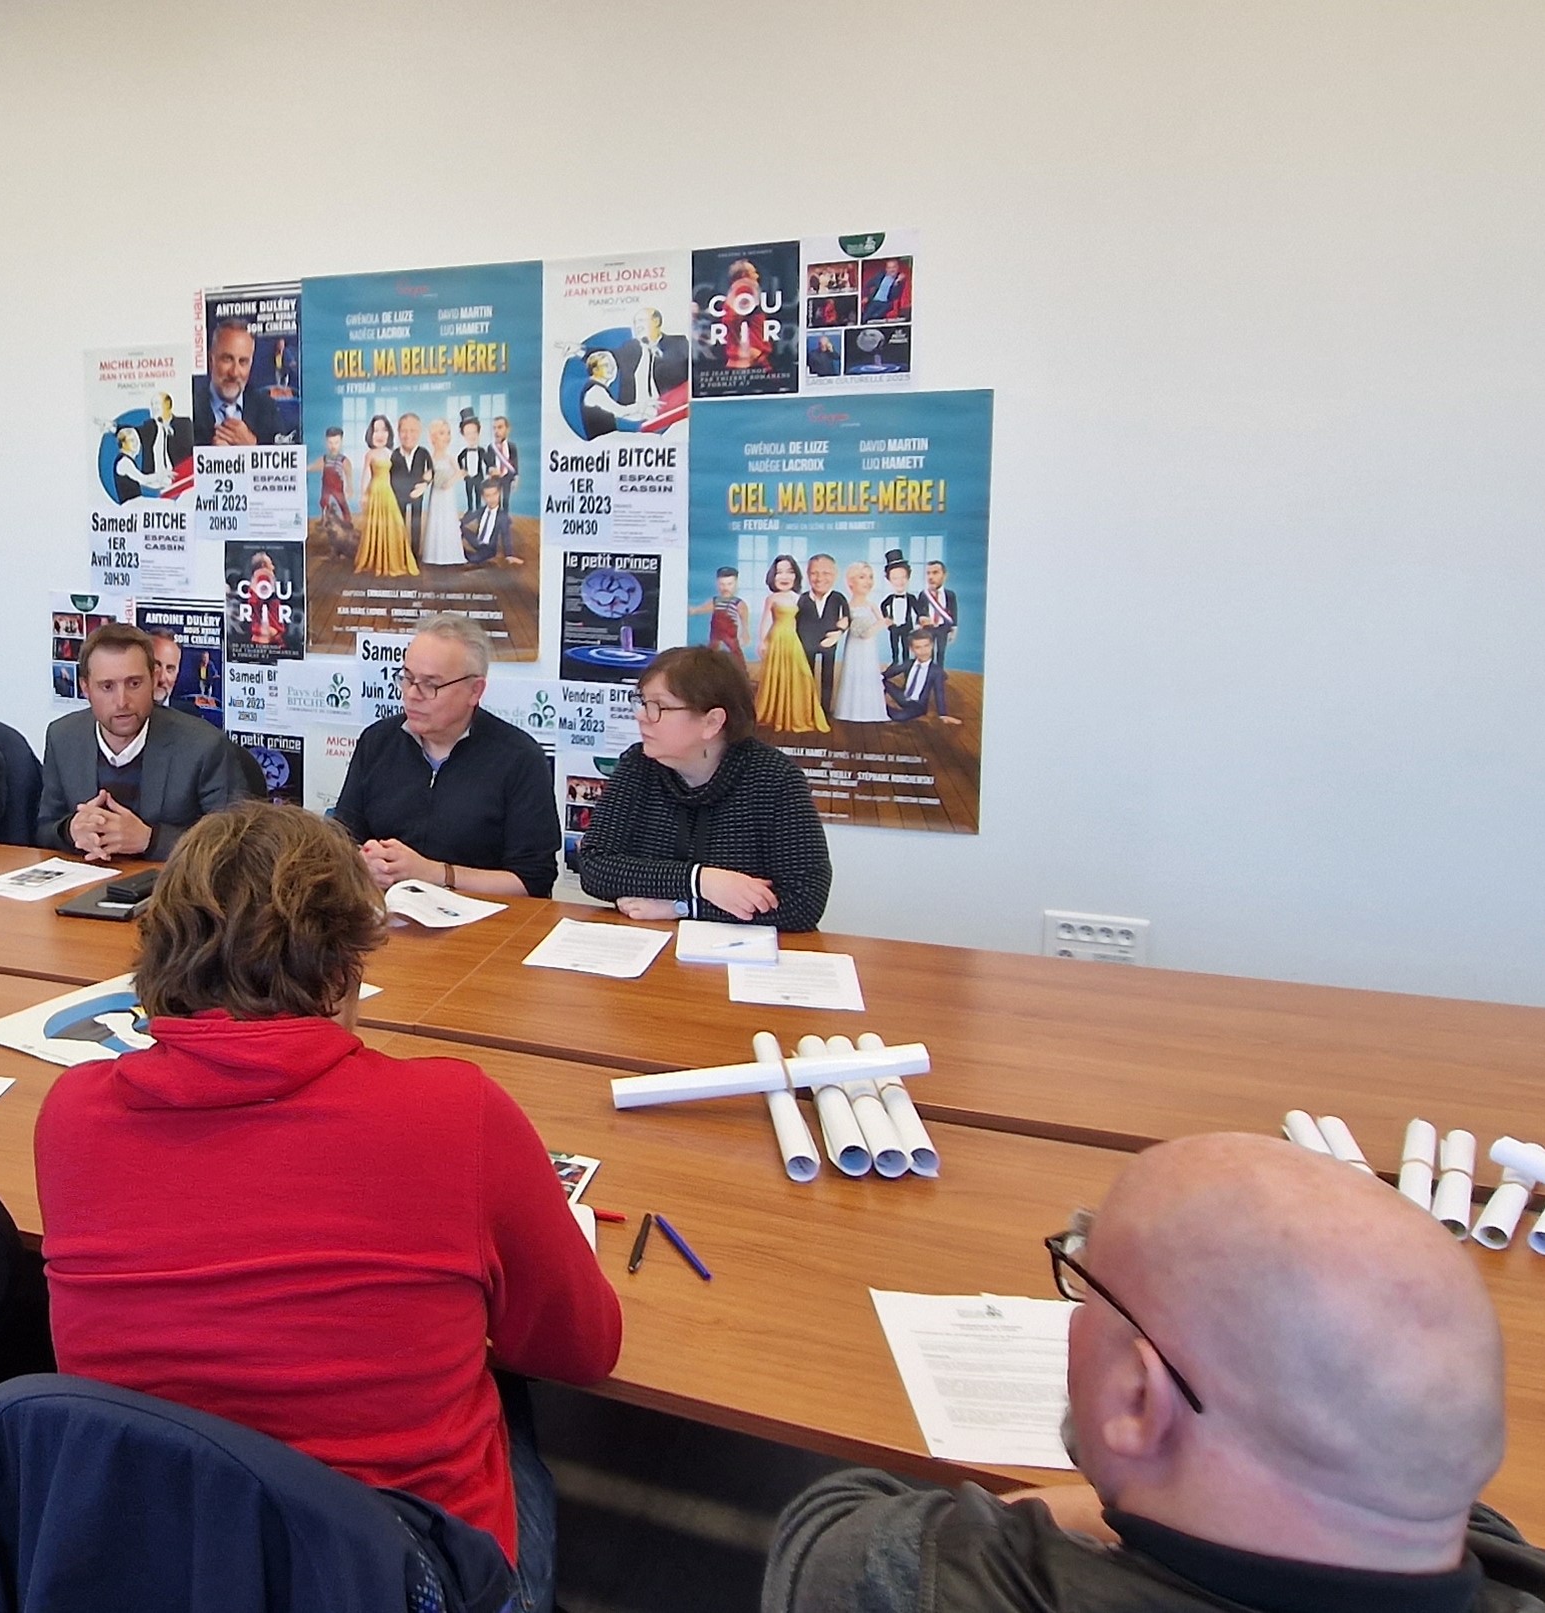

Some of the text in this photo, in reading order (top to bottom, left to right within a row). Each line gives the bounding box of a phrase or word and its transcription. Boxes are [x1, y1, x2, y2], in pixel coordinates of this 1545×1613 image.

[564, 266, 667, 285] MICHEL JONASZ
[616, 280, 668, 294] D'ANGELO
[215, 296, 297, 317] ANTOINE DULÉRY
[708, 290, 783, 318] COU
[381, 310, 393, 324] DE
[393, 309, 415, 324] LUZE
[437, 304, 494, 321] DAVID MARTIN
[246, 319, 298, 333] SON CINÉMA
[376, 325, 412, 340] LACROIX
[455, 320, 491, 335] HAMETT
[710, 319, 782, 346] RIR
[98, 357, 175, 371] MICHEL JONASZ
[333, 347, 372, 381] CIEL,
[373, 346, 399, 378] MA
[788, 441, 803, 455] DE
[803, 439, 831, 454] LUZE
[858, 437, 929, 453] DAVID MARTIN
[196, 450, 298, 475] Samedi BITCHE
[548, 447, 678, 473] Samedi BITCHE
[781, 457, 825, 472] LACROIX
[881, 454, 926, 470] HAMETT
[213, 478, 234, 494] 29
[252, 475, 297, 483] ESPACE
[569, 477, 594, 494] 1ER
[619, 474, 675, 483] ESPACE
[253, 484, 297, 493] CASSIN
[619, 484, 674, 493] CASSIN
[195, 494, 248, 512] Avril 2023
[545, 494, 612, 515] Avril 2023
[727, 481, 774, 517] CIEL,
[777, 480, 808, 515] MA
[91, 511, 187, 533] Samedi BITCHE
[208, 515, 238, 531] 20H30
[562, 518, 599, 536] 20H30
[743, 517, 781, 531] FEYDEAU
[107, 536, 127, 551] 1ER
[144, 534, 186, 542] ESPACE
[144, 543, 185, 552] CASSIN
[90, 550, 140, 569] Avril 2023
[566, 551, 659, 572] le petit prince
[103, 571, 131, 587] 20H30
[237, 579, 293, 600] COU
[145, 611, 222, 627] ANTOINE DULÉRY
[239, 603, 292, 624] RIR
[173, 633, 221, 646] SON CINÉMA
[228, 667, 264, 684] Samedi
[241, 685, 256, 697] 10
[286, 685, 324, 699] Pays de
[360, 680, 385, 700] Juin
[562, 685, 605, 705] Vendredi
[228, 695, 266, 710] Juin 2023
[286, 697, 326, 708] BITCHE
[576, 706, 594, 718] 12
[558, 716, 606, 733] Mai 2023
[240, 732, 265, 747] petit
[267, 735, 302, 750] prince
[326, 737, 358, 748] MICH
[570, 733, 596, 746] 20H30
